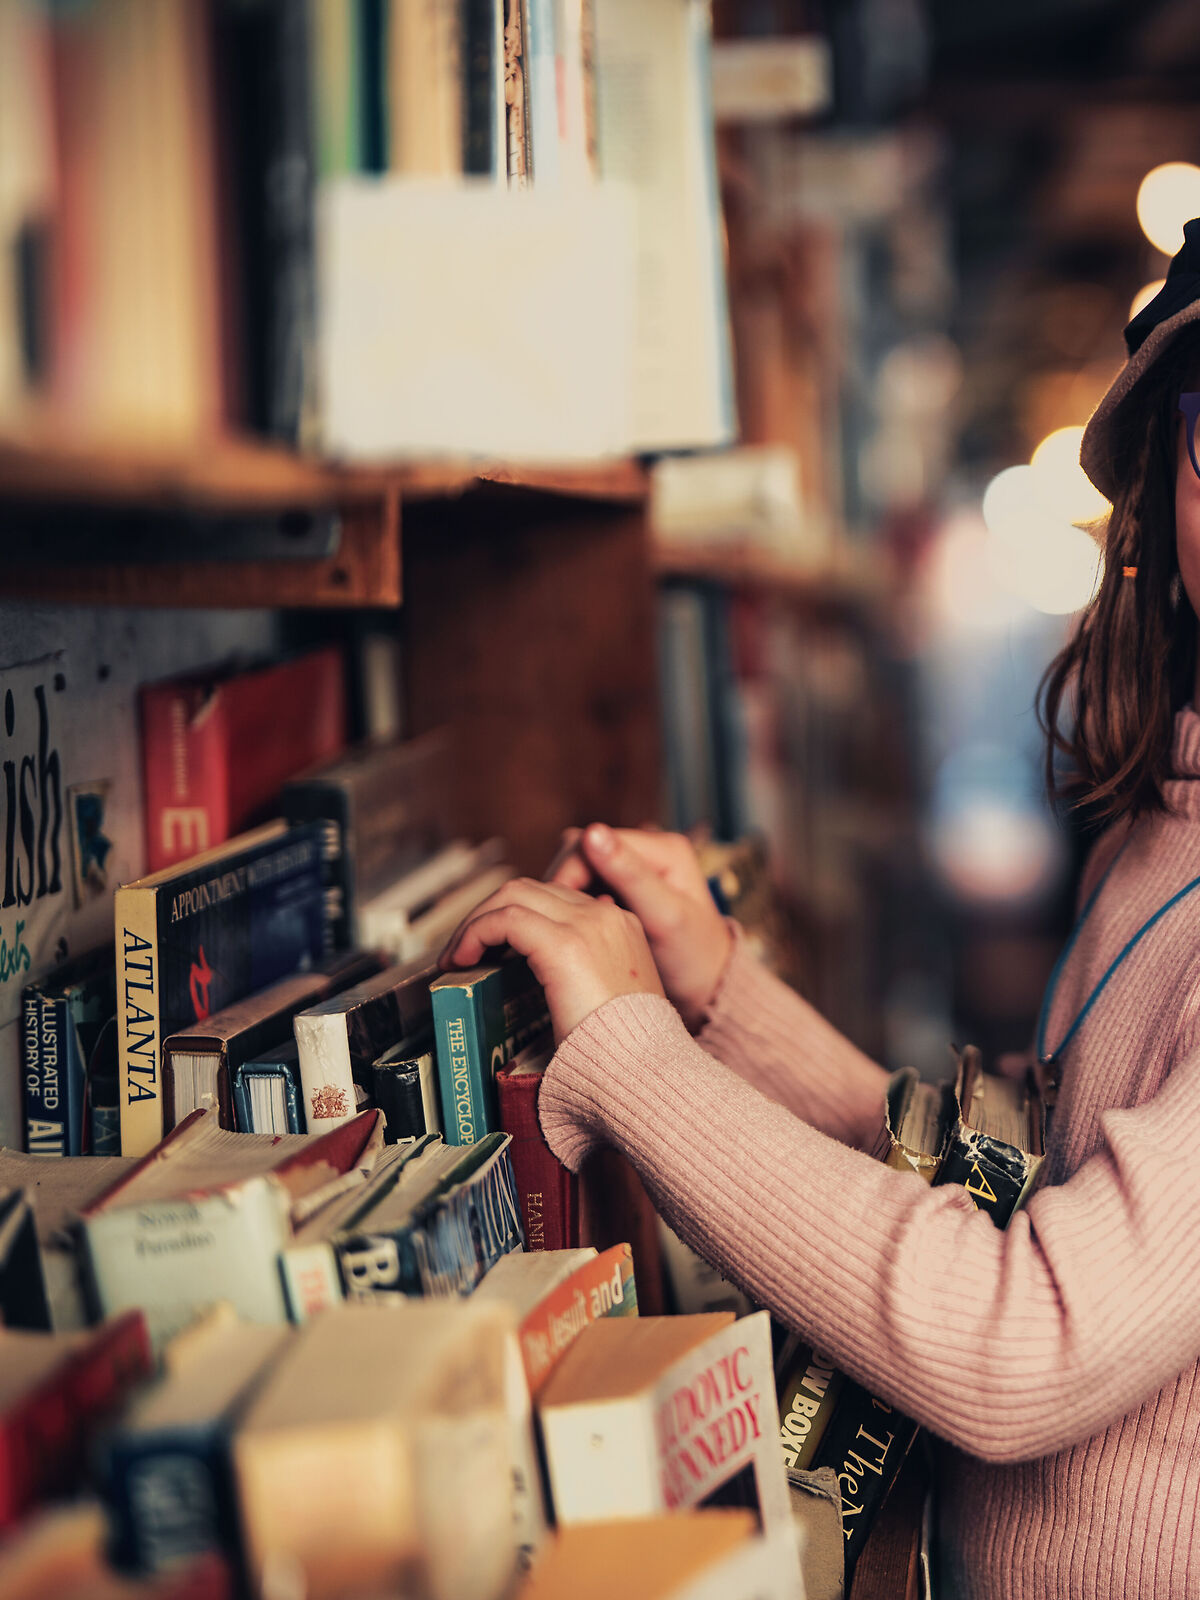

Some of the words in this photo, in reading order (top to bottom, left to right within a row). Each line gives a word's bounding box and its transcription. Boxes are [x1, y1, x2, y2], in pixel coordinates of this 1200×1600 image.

[171, 865, 247, 924] APPOINTMENT
[25, 999, 40, 1071] HISTORY
[123, 928, 158, 1106] ATLANTA
[448, 1018, 465, 1053] THE
[26, 1074, 40, 1098] OF
[452, 1056, 475, 1145] ENCYCLOP
[527, 1192, 546, 1252] HANL
[589, 1262, 624, 1319] and
[837, 1423, 895, 1495] The
